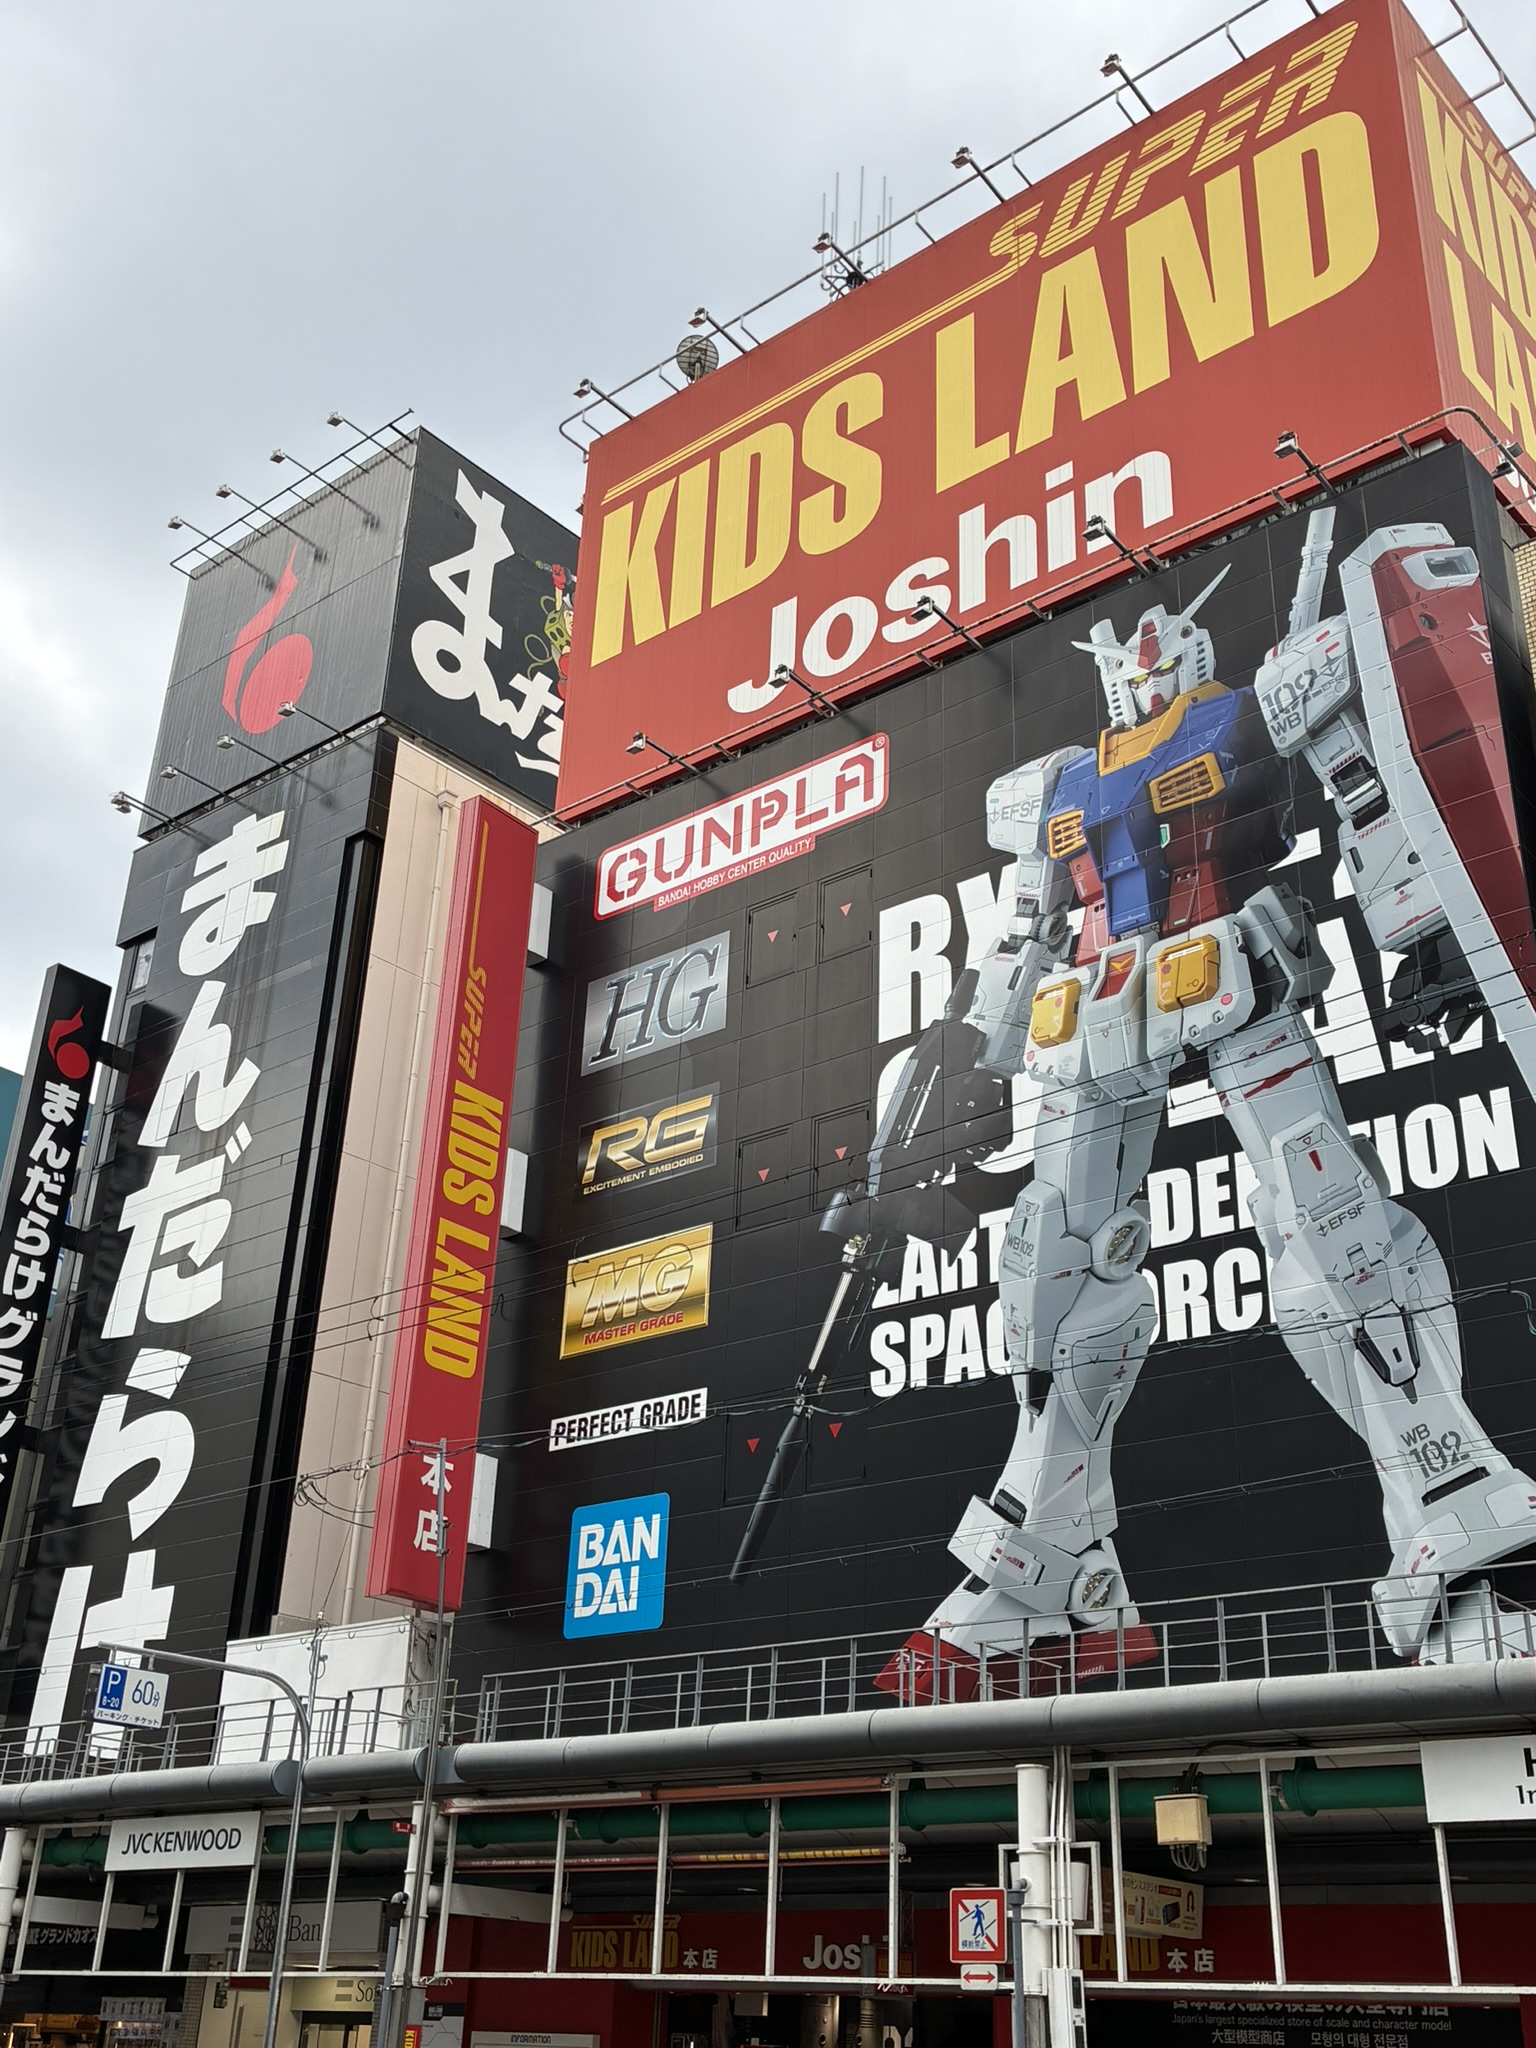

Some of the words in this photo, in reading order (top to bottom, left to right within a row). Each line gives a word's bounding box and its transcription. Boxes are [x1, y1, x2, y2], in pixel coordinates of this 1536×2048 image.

[989, 20, 1359, 272] SUPER
[590, 371, 884, 669] KIDS
[936, 111, 1380, 495] LAND
[727, 450, 1175, 714] Joshin
[1270, 711, 1302, 737] WB
[606, 752, 874, 903] GUNPLA
[1001, 799, 1041, 821] EFSF
[658, 887, 691, 907] BANDAI
[693, 873, 725, 893] HOBBY
[727, 858, 766, 880] CENTER
[768, 838, 812, 860] QUALITY
[457, 965, 487, 1081] SUPER
[588, 943, 721, 1066] HG
[443, 1079, 504, 1216] KIDS
[582, 1094, 713, 1184] RG
[583, 1170, 646, 1195] EXCITEMENT
[648, 1153, 704, 1178] EMBODIED
[1328, 1201, 1365, 1230] EFSF
[23, 811, 290, 1760] まんだらけ
[423, 1217, 491, 1379] LAND
[580, 1243, 694, 1331] MG
[584, 1322, 636, 1345] MASTER
[639, 1310, 684, 1333] GRADE
[554, 1407, 634, 1446] PERFECT
[639, 1393, 702, 1429] GRADE
[1400, 1423, 1430, 1447] WB
[1409, 1431, 1470, 1479] 102
[413, 1455, 454, 1552] 本店
[577, 1513, 661, 1570] BAN
[573, 1565, 640, 1618] DAI
[102, 1696, 120, 1708] 8-20
[107, 1670, 122, 1694] P
[132, 1679, 160, 1707] 60分
[96, 1711, 159, 1725] パーキング・チケット
[122, 1827, 242, 1855] JVCKENWOOD
[570, 1931, 618, 1969] KIDS
[622, 1931, 679, 1969] LAD
[683, 1948, 718, 1969] 本店
[1167, 1947, 1215, 1973] 本店
[510, 2034, 552, 2044] INFORMATION
[1172, 2013, 1204, 2025] Japan's
[1206, 2014, 1235, 2026] largest
[1237, 2014, 1285, 2027] specialized
[1287, 2016, 1311, 2027] store
[1313, 2017, 1324, 2027] of
[1325, 2017, 1350, 2028] scale
[1352, 2018, 1370, 2029] and
[1372, 2018, 1419, 2030] character
[1421, 2020, 1452, 2031] model
[1211, 2029, 1286, 2046] 大型模型商店
[1310, 2031, 1345, 2048] 모형의
[1347, 2032, 1370, 2048] 대형
[1373, 2033, 1409, 2048] 전문점
